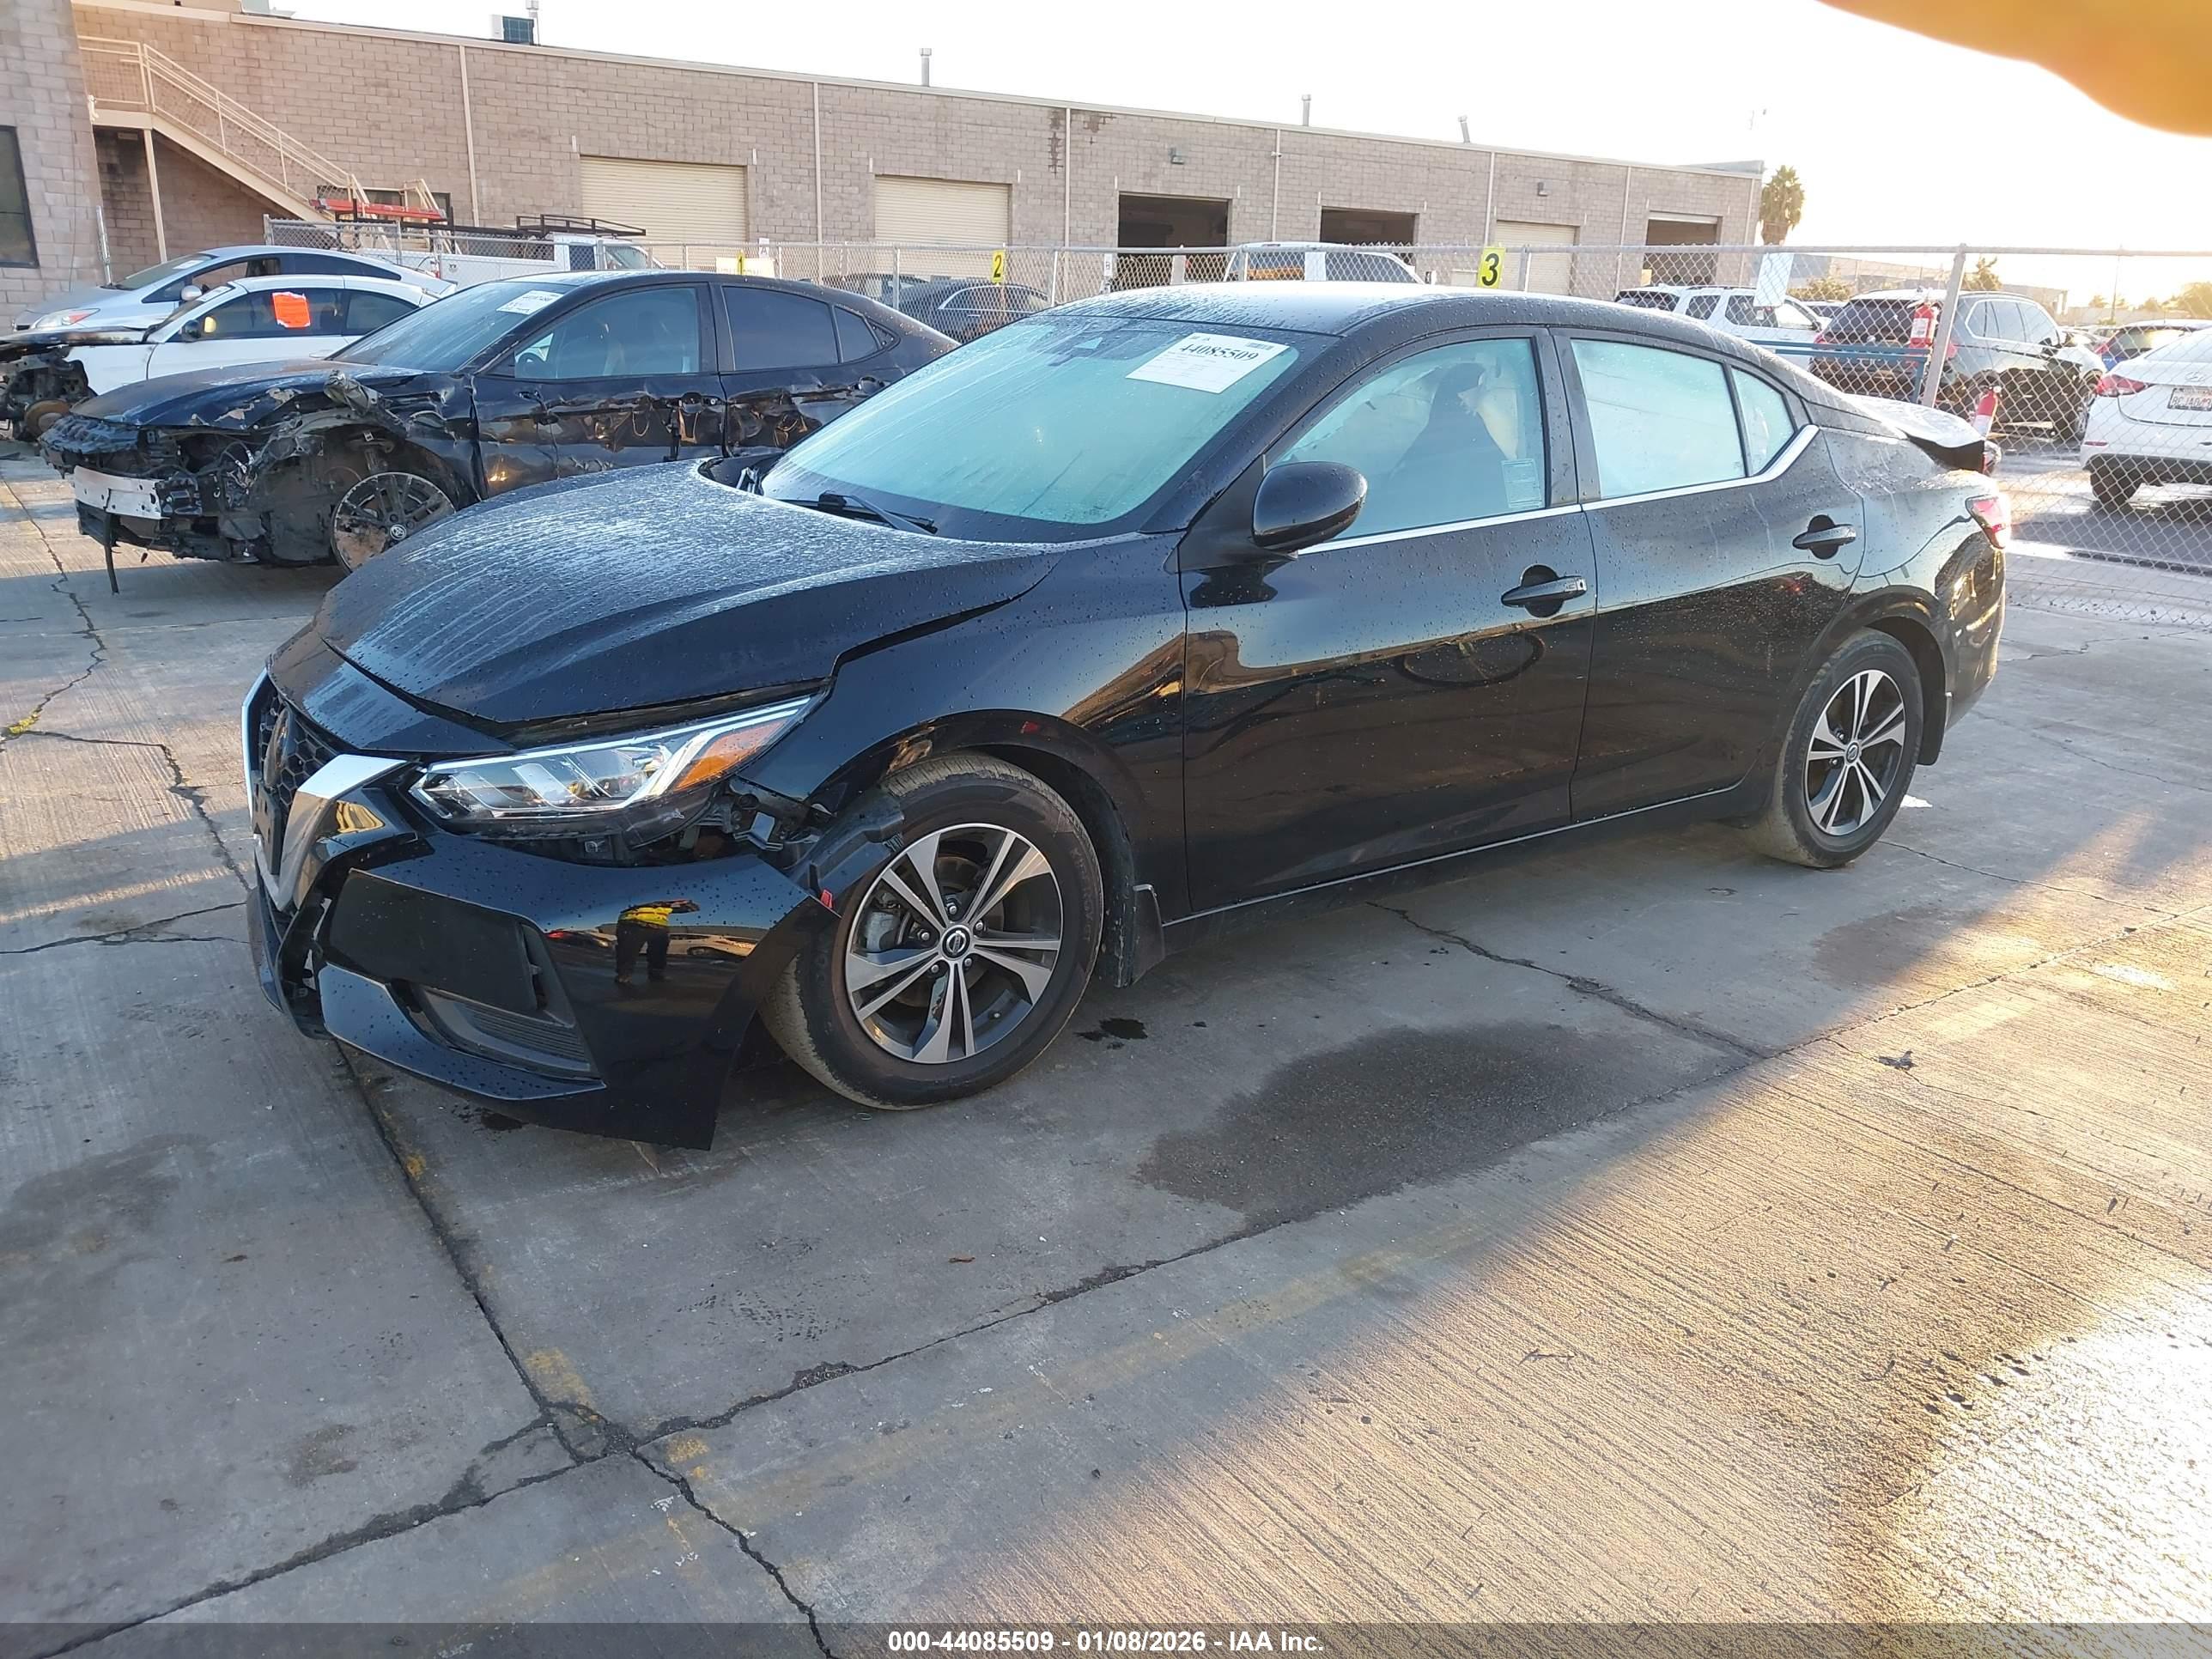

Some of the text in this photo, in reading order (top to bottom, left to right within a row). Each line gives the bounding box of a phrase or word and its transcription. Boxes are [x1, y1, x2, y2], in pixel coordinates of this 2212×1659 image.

[994, 254, 1002, 277] 2
[1481, 253, 1499, 286] 3
[1179, 343, 1259, 361] 44085509
